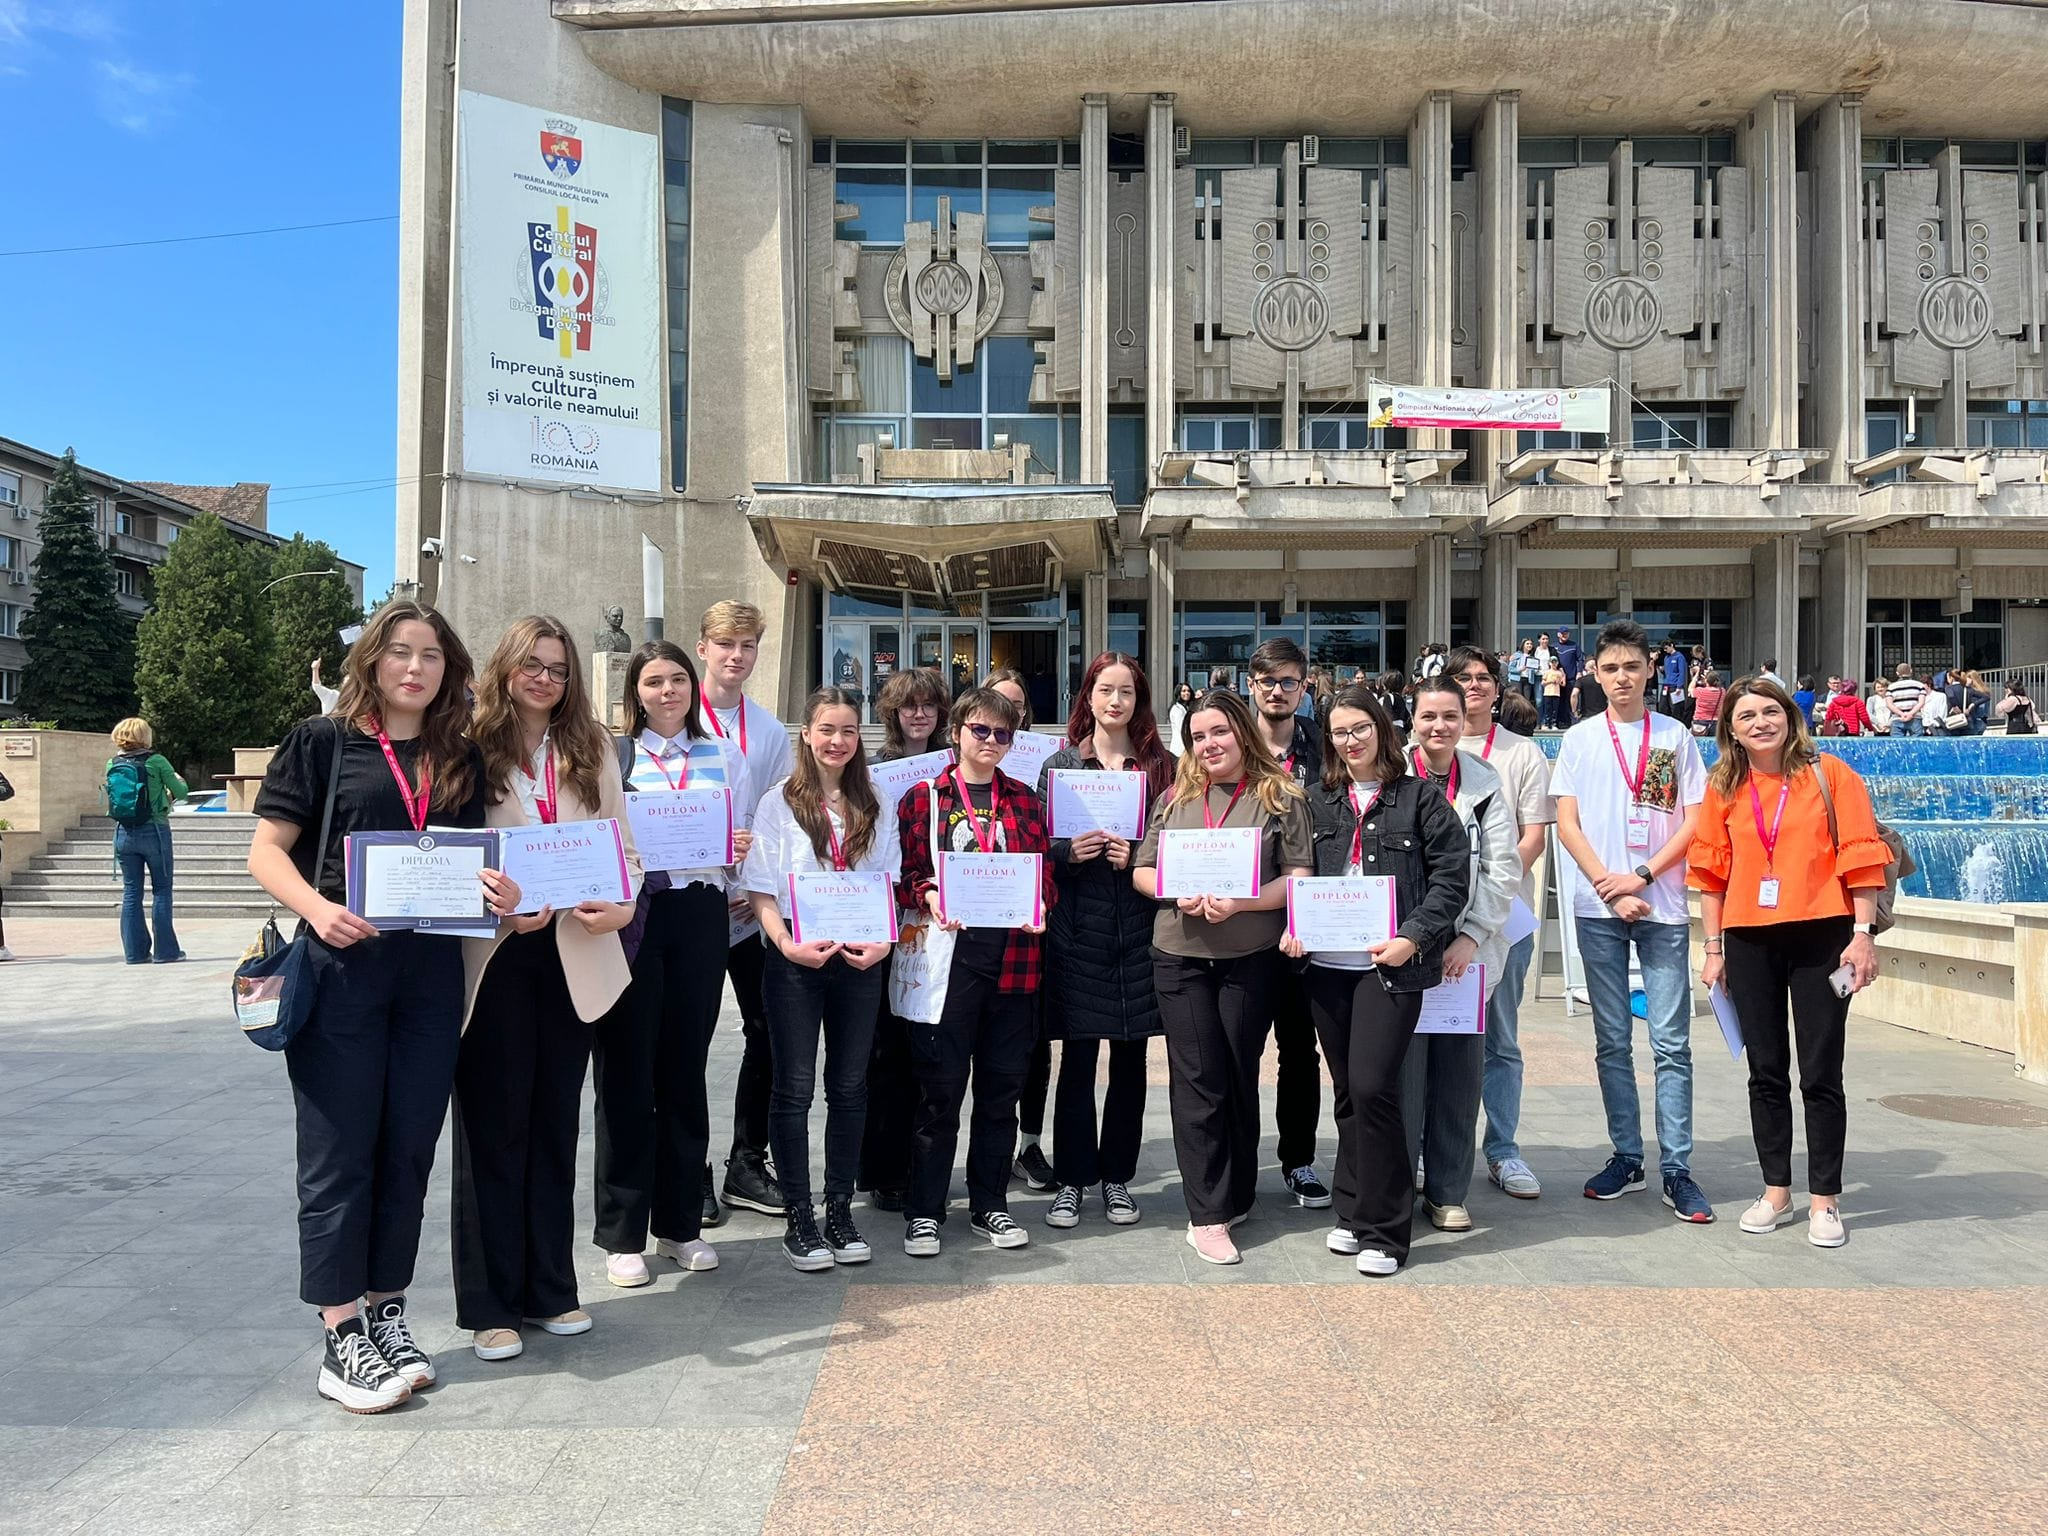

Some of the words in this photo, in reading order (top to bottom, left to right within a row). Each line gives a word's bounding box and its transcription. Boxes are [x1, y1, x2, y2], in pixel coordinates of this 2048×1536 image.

[524, 183, 559, 197] CONSILIUL
[559, 191, 580, 202] LOCAL
[581, 196, 599, 205] DEVA
[546, 180, 591, 195] MUNICIPIULUI
[591, 189, 610, 199] DEVA
[534, 225, 590, 247] Centrul
[533, 238, 592, 261] Cultural
[546, 316, 581, 333] Deva
[560, 306, 616, 327] Muntean
[489, 351, 565, 379] Împreună
[568, 369, 636, 388] susținem
[531, 379, 597, 400] cultura
[487, 389, 499, 406] și
[504, 392, 563, 410] valorile
[567, 401, 639, 420] neamului!
[530, 453, 600, 470] ROMÂNIA
